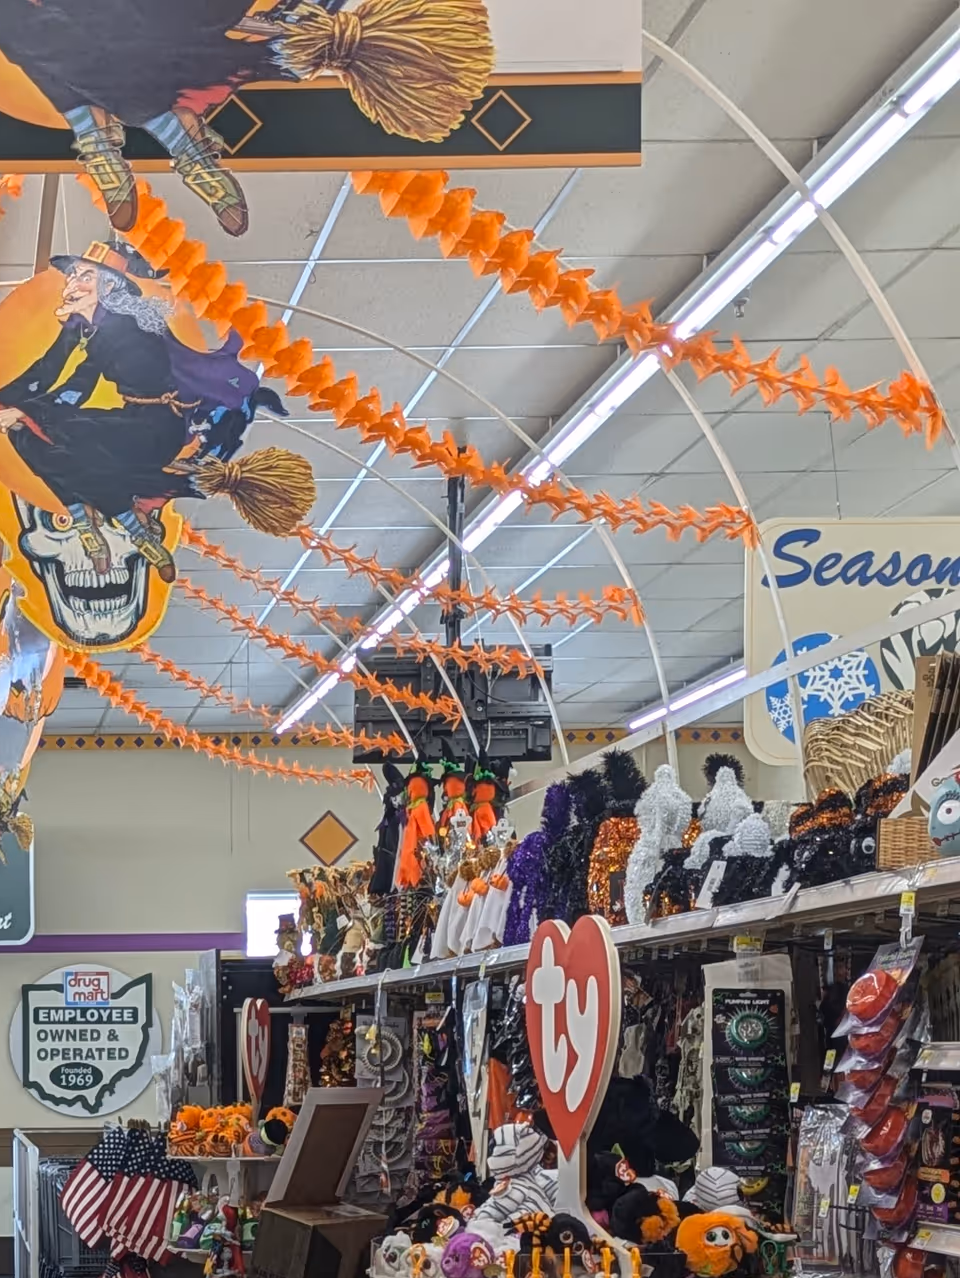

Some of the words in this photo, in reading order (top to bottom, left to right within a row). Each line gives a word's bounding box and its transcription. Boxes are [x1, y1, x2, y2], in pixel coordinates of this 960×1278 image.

[761, 528, 960, 588] Season
[69, 976, 101, 993] drug
[73, 987, 108, 1002] mart
[38, 1009, 134, 1022] EMPLOYEE
[533, 937, 598, 1112] ty
[36, 1028, 100, 1043] OWNED
[107, 1028, 119, 1042] &
[36, 1047, 129, 1062] OPERATED
[60, 1066, 93, 1075] Founded
[60, 1074, 94, 1087] 1969
